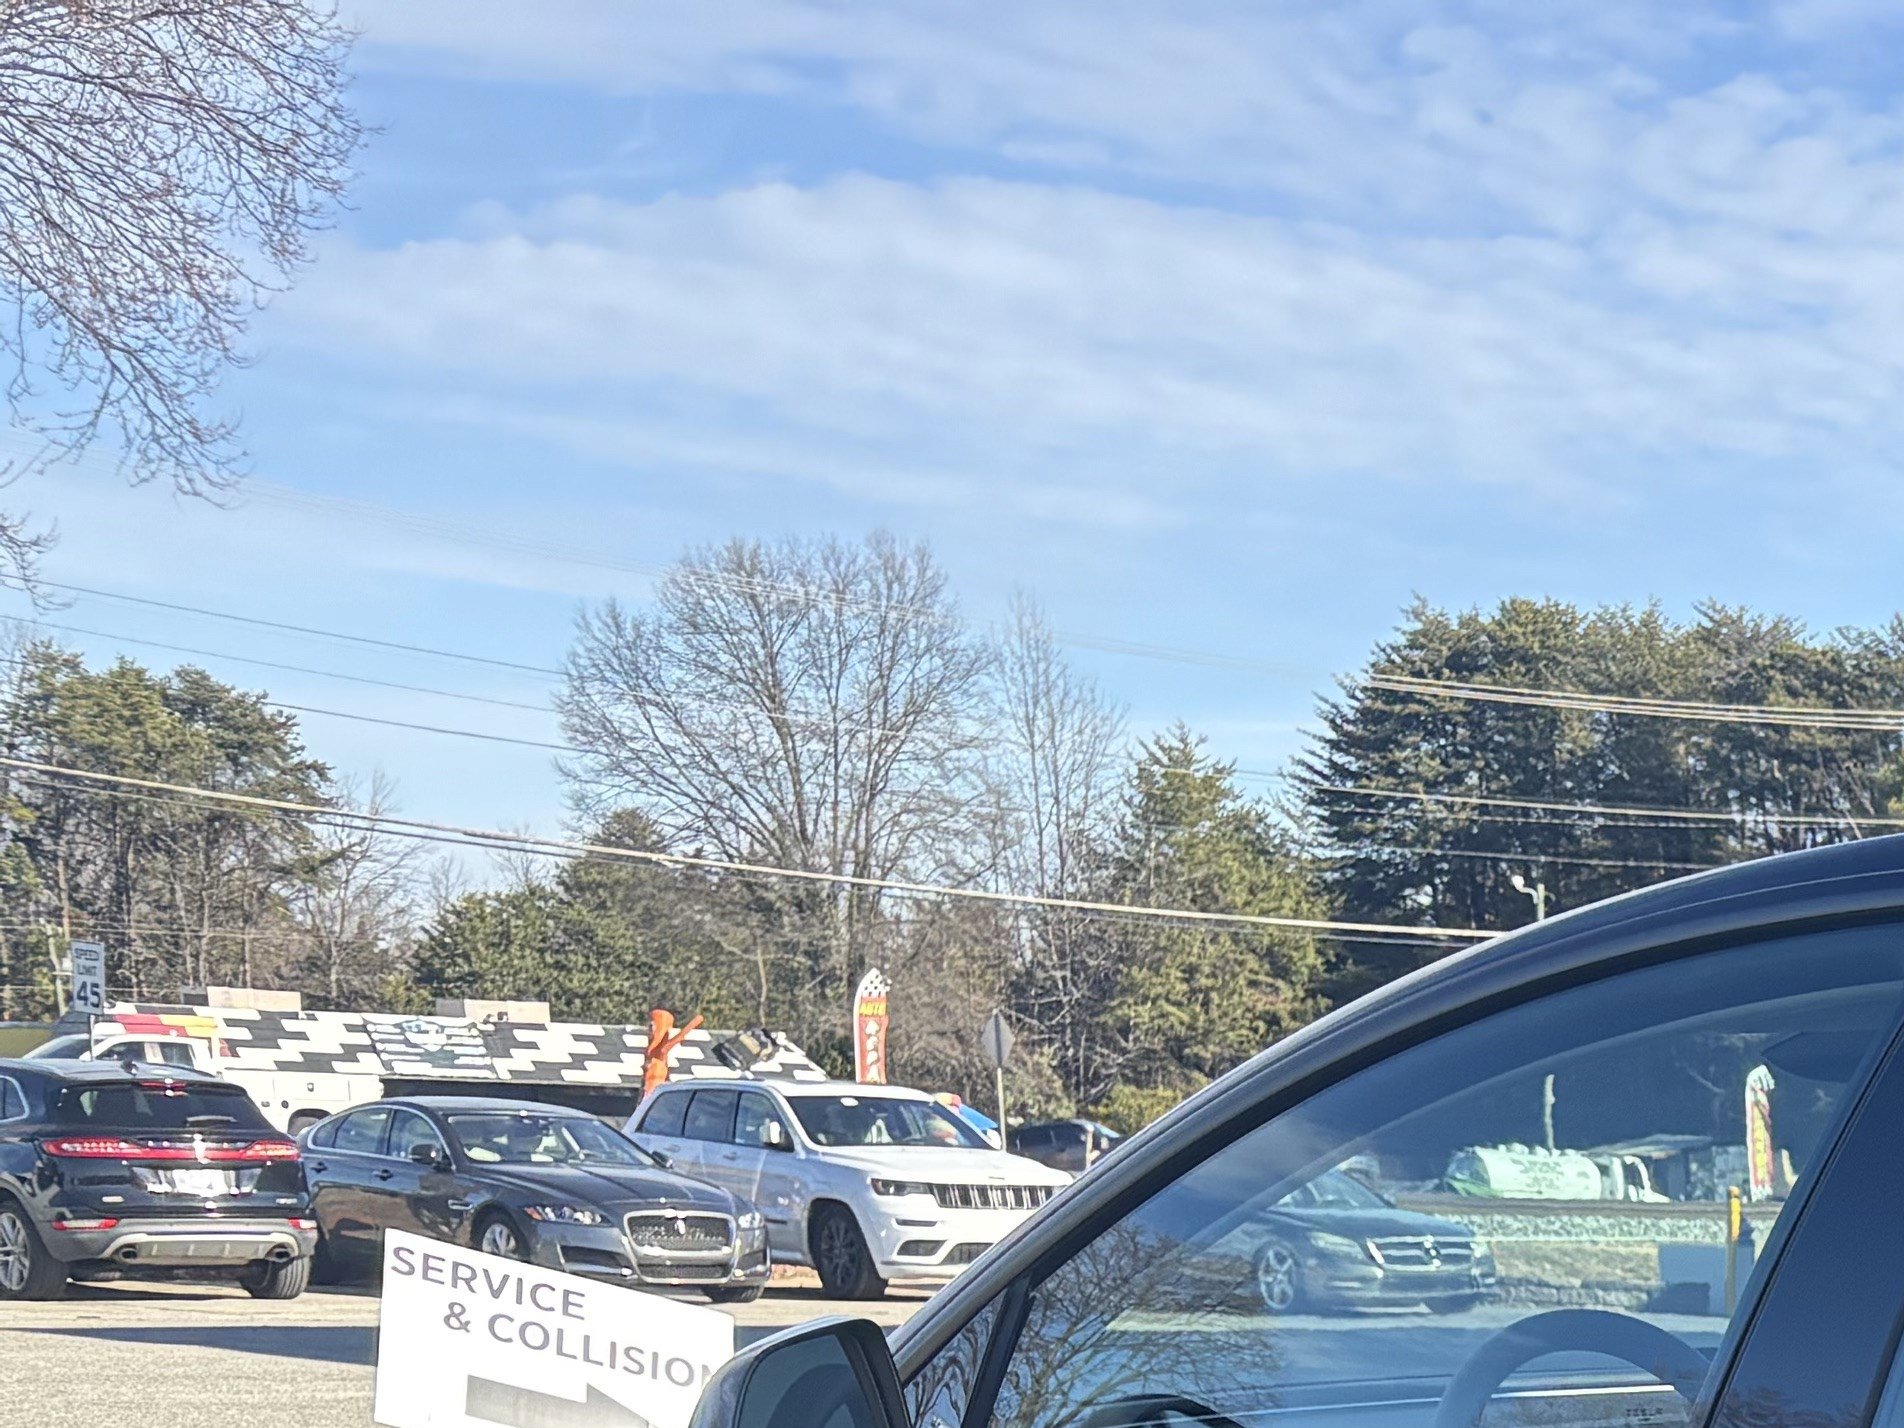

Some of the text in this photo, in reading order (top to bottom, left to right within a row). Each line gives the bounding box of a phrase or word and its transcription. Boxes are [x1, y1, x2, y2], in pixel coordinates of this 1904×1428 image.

[77, 981, 101, 1008] 45
[391, 1246, 586, 1321] SERVICE
[443, 1302, 712, 1388] & COLLISIO
